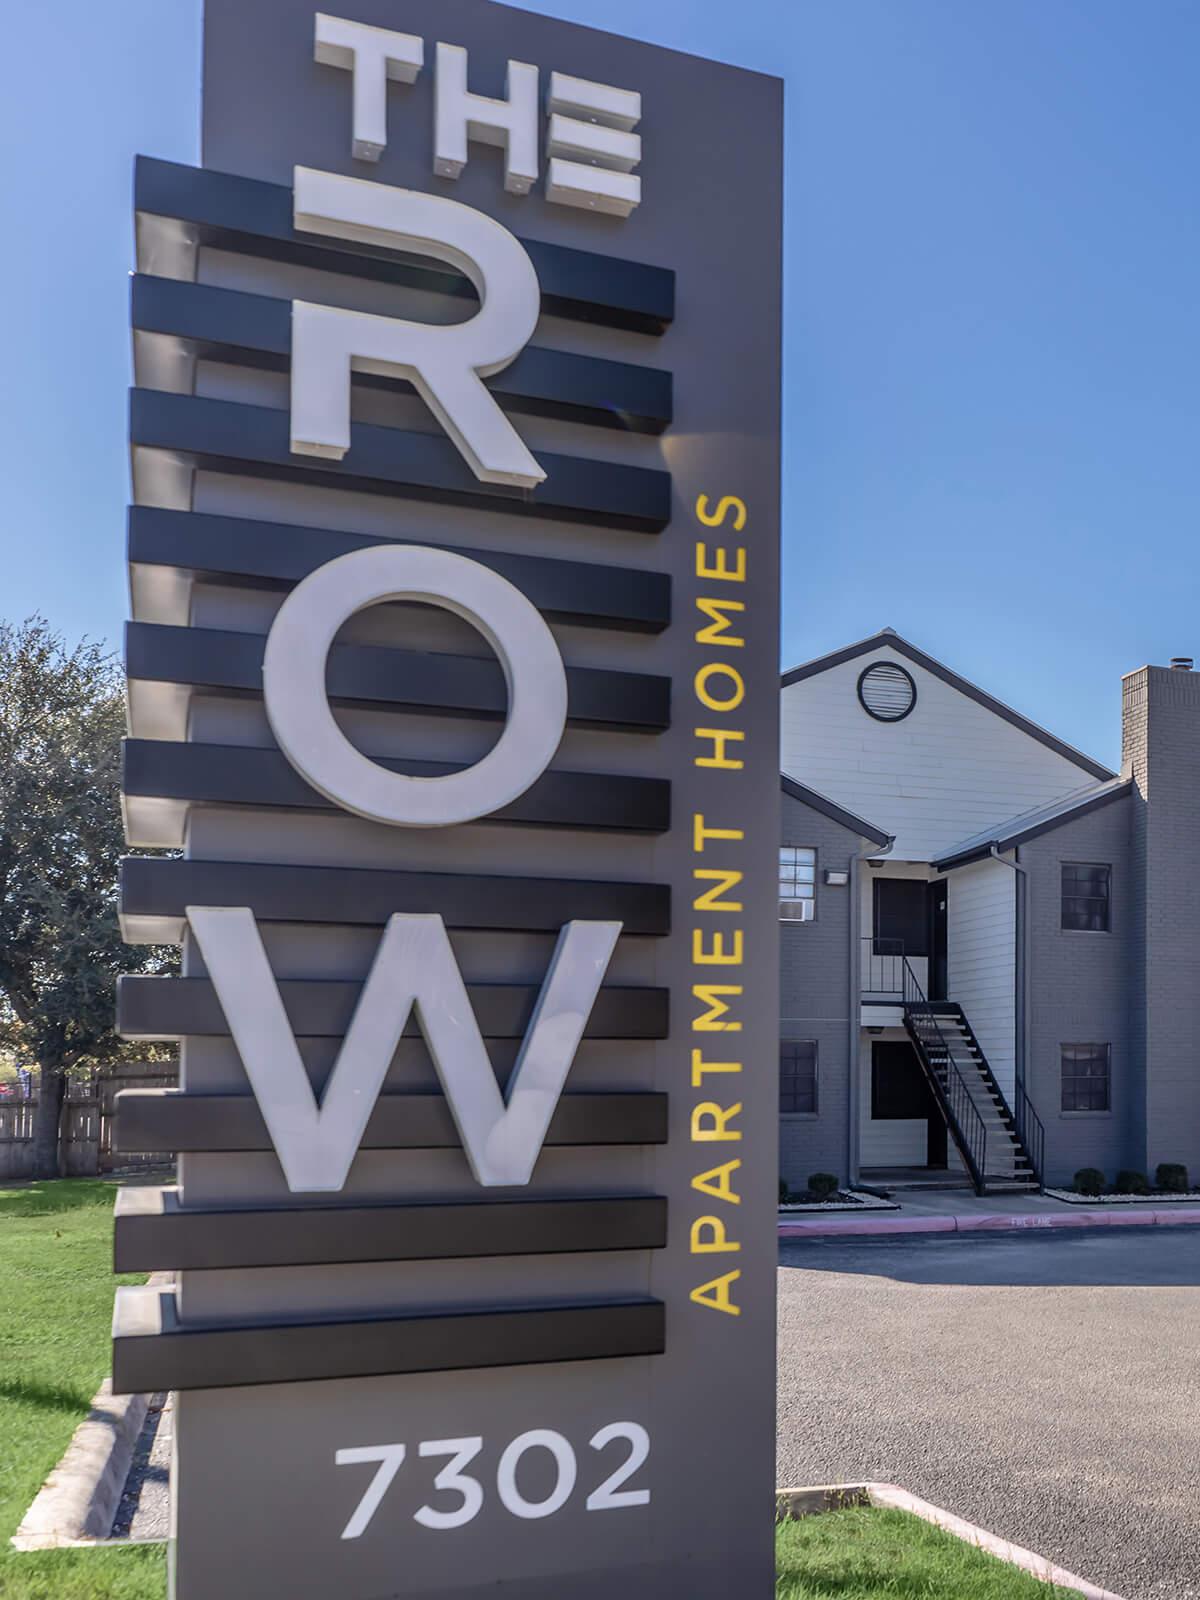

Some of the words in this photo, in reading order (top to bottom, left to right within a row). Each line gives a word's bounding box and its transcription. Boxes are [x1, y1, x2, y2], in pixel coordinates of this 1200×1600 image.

[313, 12, 641, 218] THE
[694, 493, 747, 770] HOMES
[690, 813, 744, 1316] APARTMENT
[335, 1421, 651, 1540] 7302
